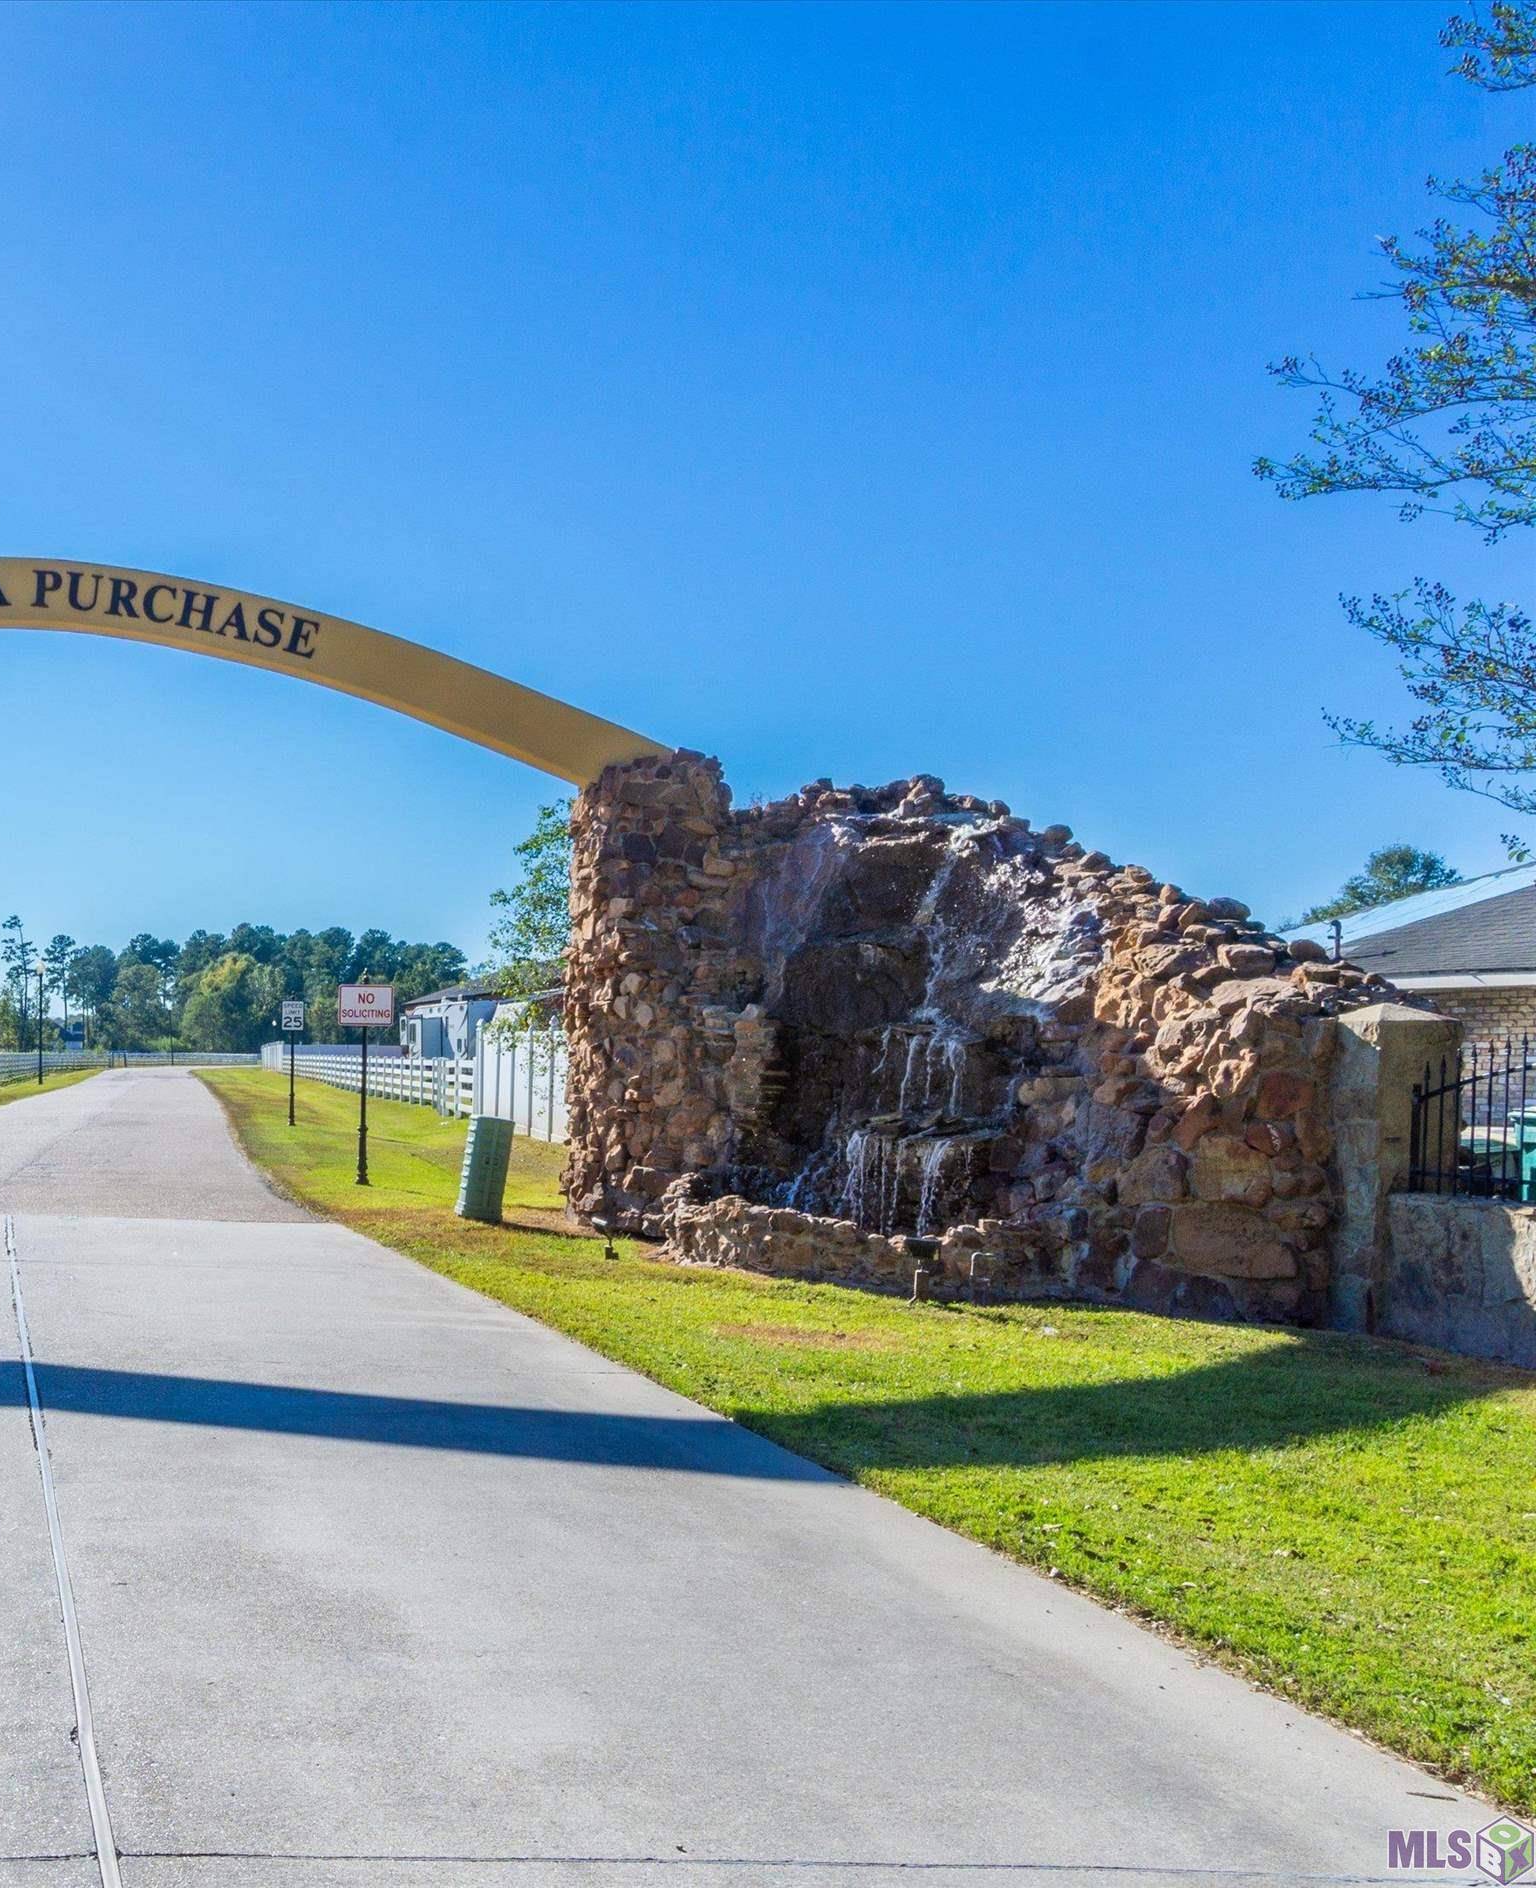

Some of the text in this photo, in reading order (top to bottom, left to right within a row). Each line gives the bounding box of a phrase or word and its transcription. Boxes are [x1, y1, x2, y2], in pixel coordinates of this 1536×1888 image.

[30, 568, 321, 659] PURCHASE
[358, 993, 375, 1004] NO
[342, 1009, 391, 1018] SOLICITING
[283, 1016, 303, 1028] 25
